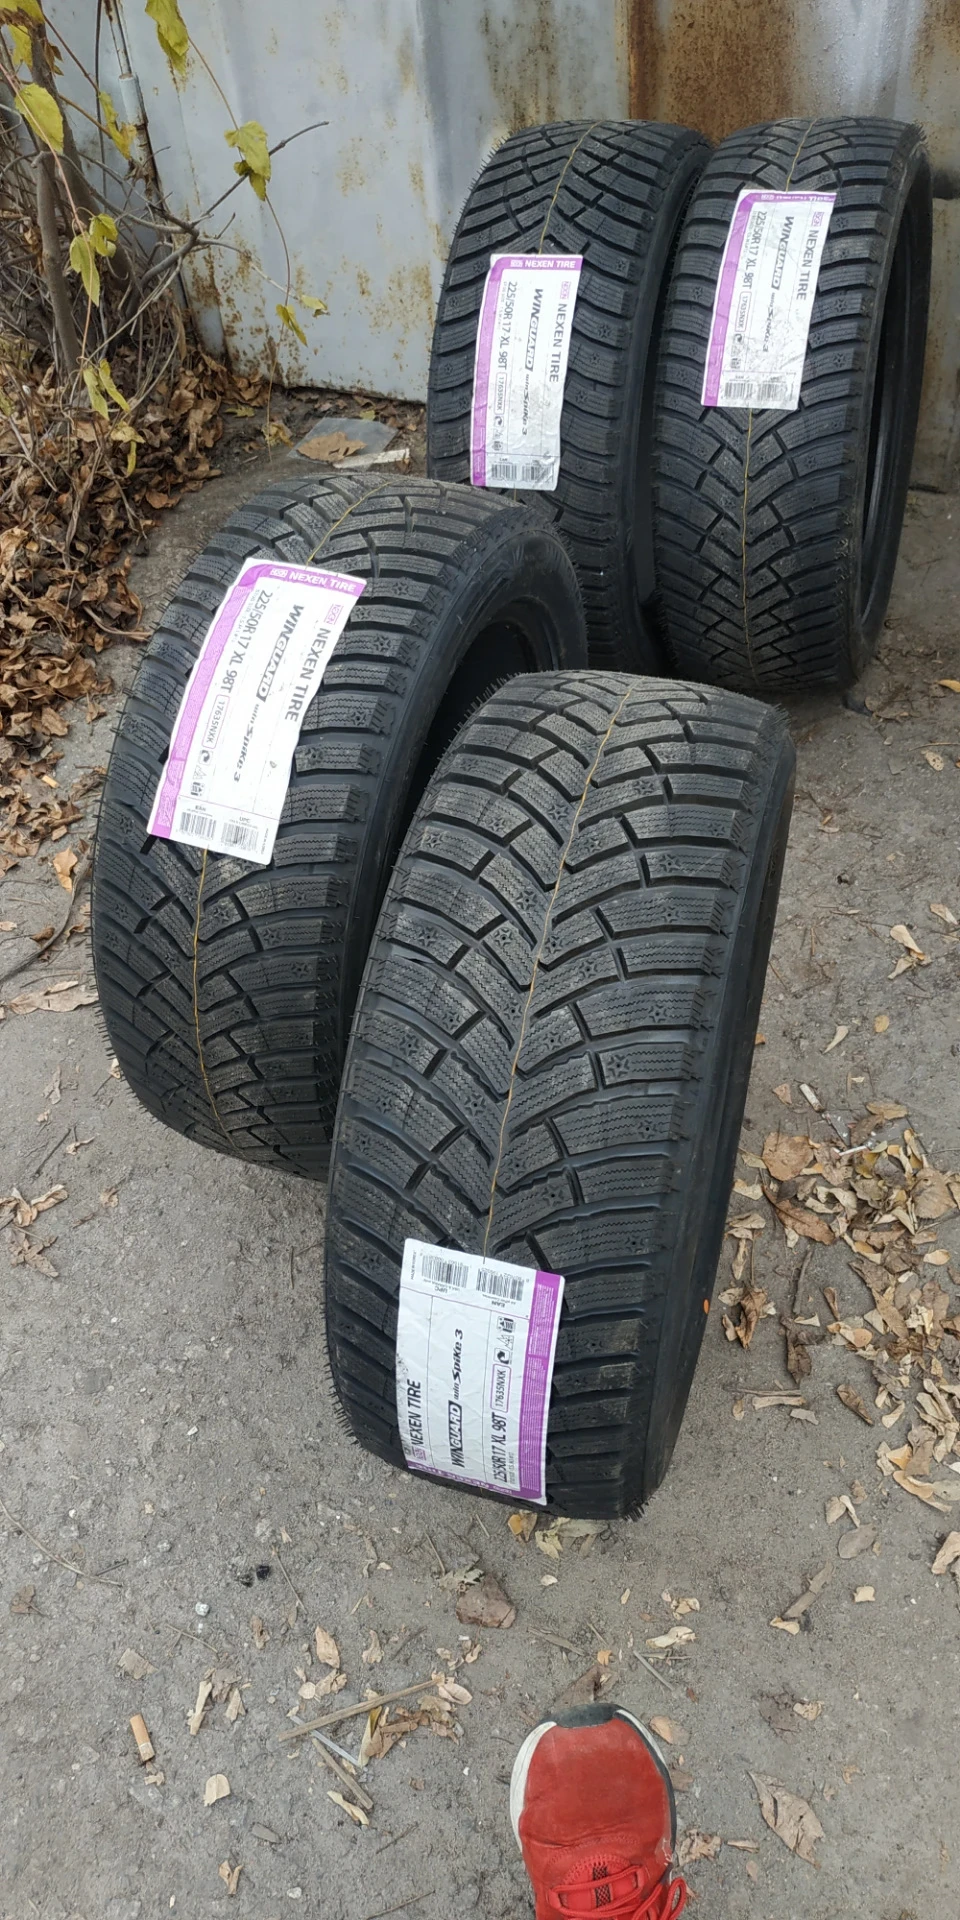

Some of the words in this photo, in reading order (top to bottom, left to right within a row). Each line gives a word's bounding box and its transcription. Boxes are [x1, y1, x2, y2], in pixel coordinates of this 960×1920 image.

[771, 215, 795, 291] WINGUARD
[802, 229, 818, 268] NEXEN
[524, 260, 554, 268] NEXEN
[555, 260, 576, 269] TIRE
[746, 257, 756, 273] XL
[742, 271, 754, 289] 98T
[796, 270, 811, 301] TIRE
[525, 288, 544, 372] WINGUARD
[551, 303, 568, 348] NEXEN
[499, 336, 511, 352] XL
[497, 352, 508, 370] 98T
[549, 352, 562, 383] TIRE
[496, 376, 505, 411] 17635NXK
[522, 427, 528, 436] 3
[289, 571, 328, 586] NEXEN
[328, 579, 357, 592] TIRE
[230, 651, 247, 672] XL
[255, 604, 305, 703] WINGUARD
[299, 626, 332, 684] NEXEN
[220, 669, 238, 695] 98T
[284, 682, 311, 722] TIRE
[206, 700, 226, 744] 17635NXK
[233, 770, 242, 783] 3
[455, 1328, 464, 1340] 3
[407, 1379, 422, 1409] TIRE
[494, 1369, 507, 1408] 17635NXK
[408, 1411, 424, 1446] NEXEN
[448, 1400, 466, 1468] WINGUARD
[491, 1411, 507, 1433] 98T
[491, 1433, 507, 1446] XL
